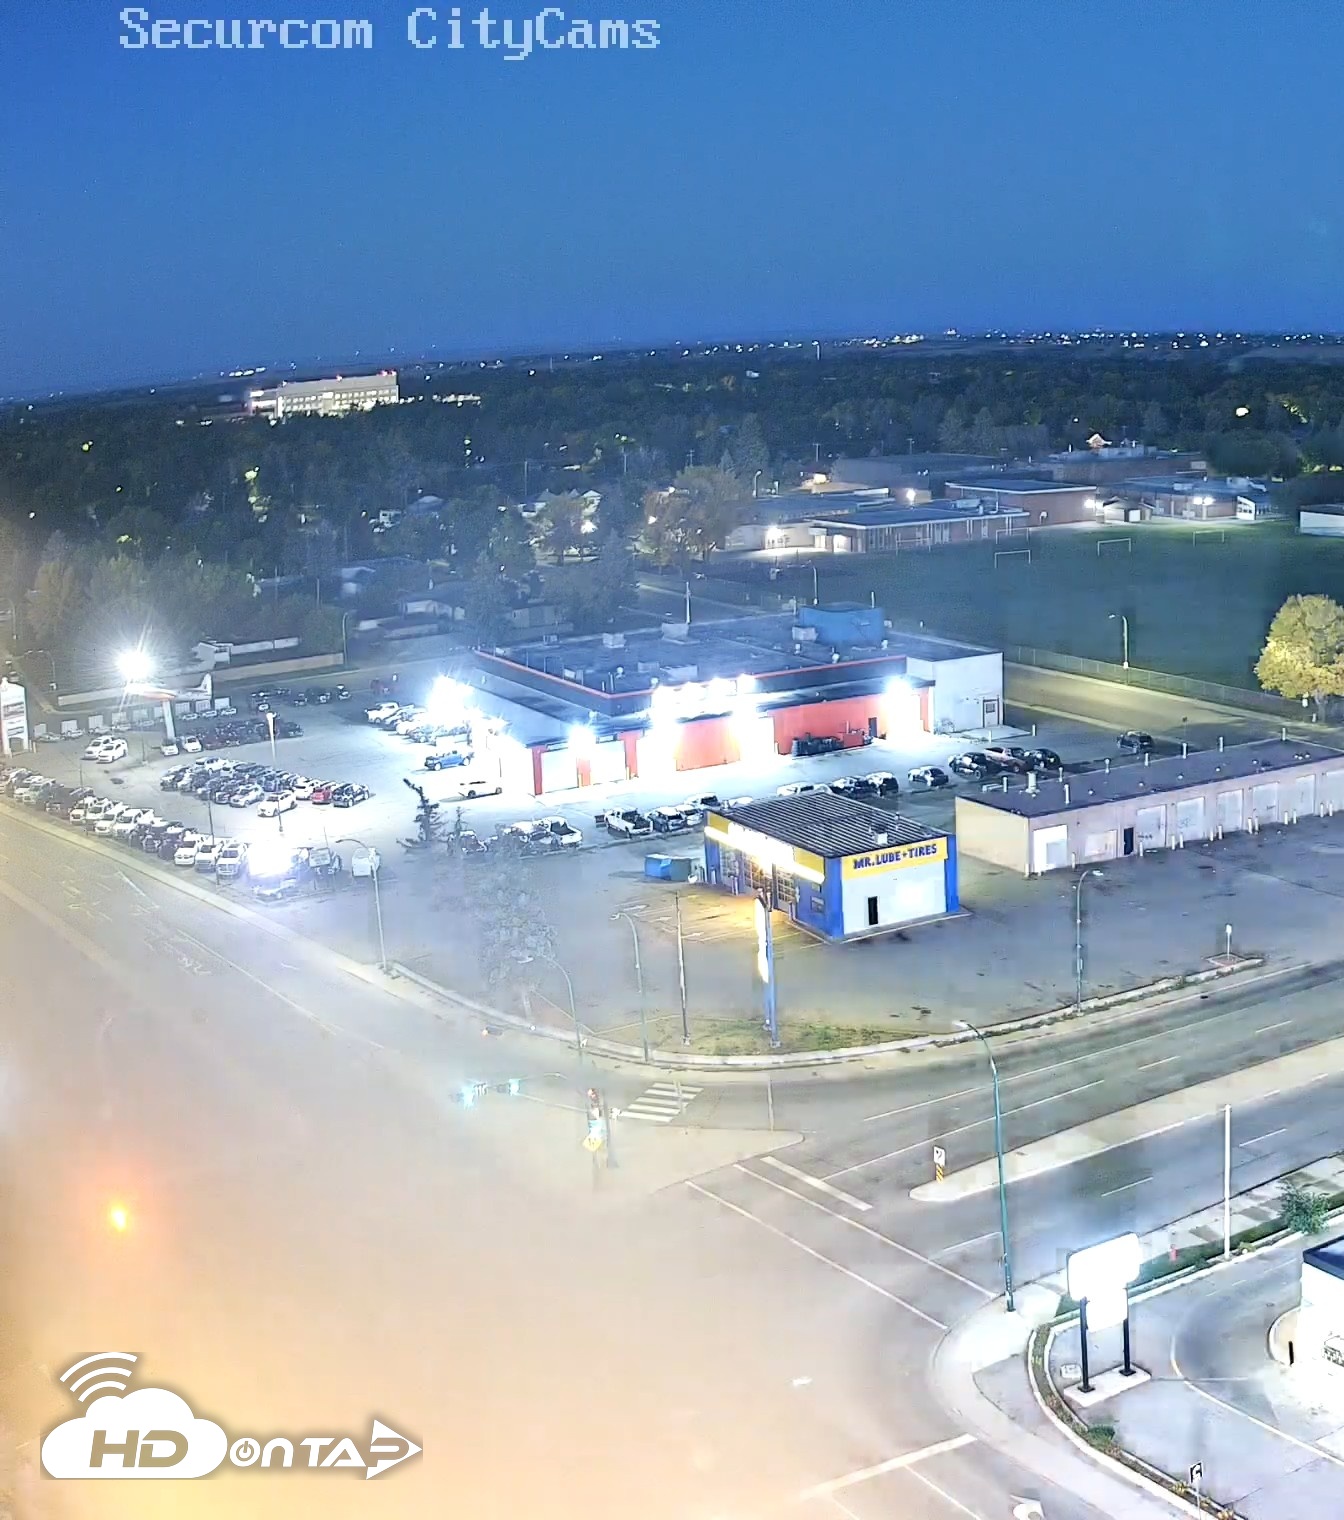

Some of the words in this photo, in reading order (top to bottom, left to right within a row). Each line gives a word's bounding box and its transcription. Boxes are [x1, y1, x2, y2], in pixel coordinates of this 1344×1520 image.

[853, 856, 875, 870] MR.
[875, 851, 901, 866] LUBE
[907, 843, 937, 858] TIRES
